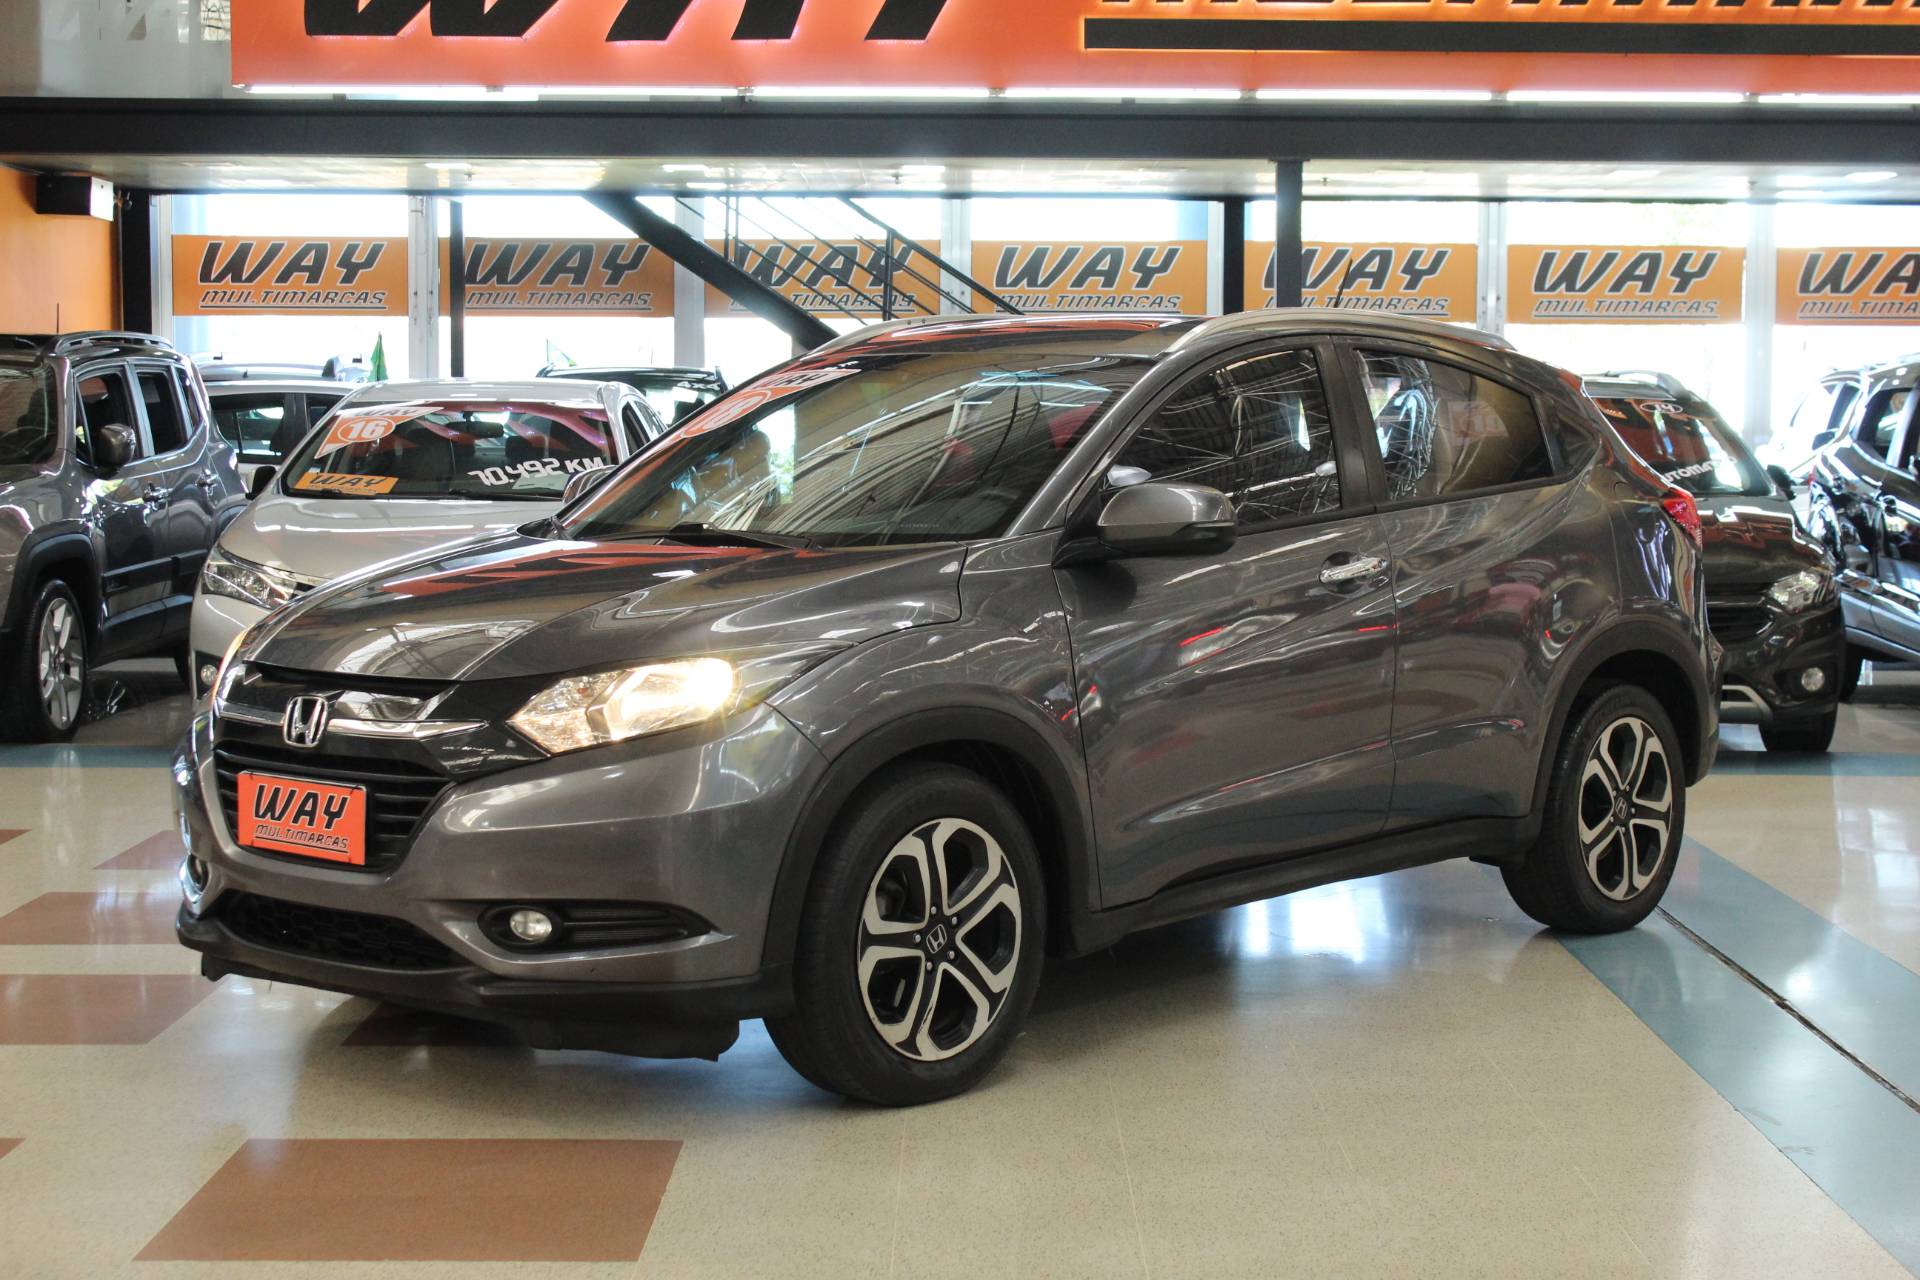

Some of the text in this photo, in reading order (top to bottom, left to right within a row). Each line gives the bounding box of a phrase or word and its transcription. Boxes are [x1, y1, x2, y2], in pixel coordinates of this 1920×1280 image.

[199, 240, 388, 286] WAY
[464, 241, 652, 287] WAY
[730, 243, 915, 289] WAY
[994, 245, 1183, 290] WAY
[1263, 247, 1452, 292] WAY
[1532, 250, 1720, 295] WAY
[1798, 252, 1920, 296] WA
[200, 290, 387, 304] MULTIMARCAS
[465, 291, 652, 306] MULTIMARCAS
[996, 294, 1183, 309] MULTIMARCAS
[1534, 299, 1719, 314] MULTIMARCAS
[1800, 301, 1920, 314] MULTIMA
[346, 419, 389, 440] 16
[564, 456, 604, 474] KM
[309, 474, 388, 487] WAY
[253, 784, 350, 831] WAY
[255, 824, 350, 849] MULTIMARCAS
